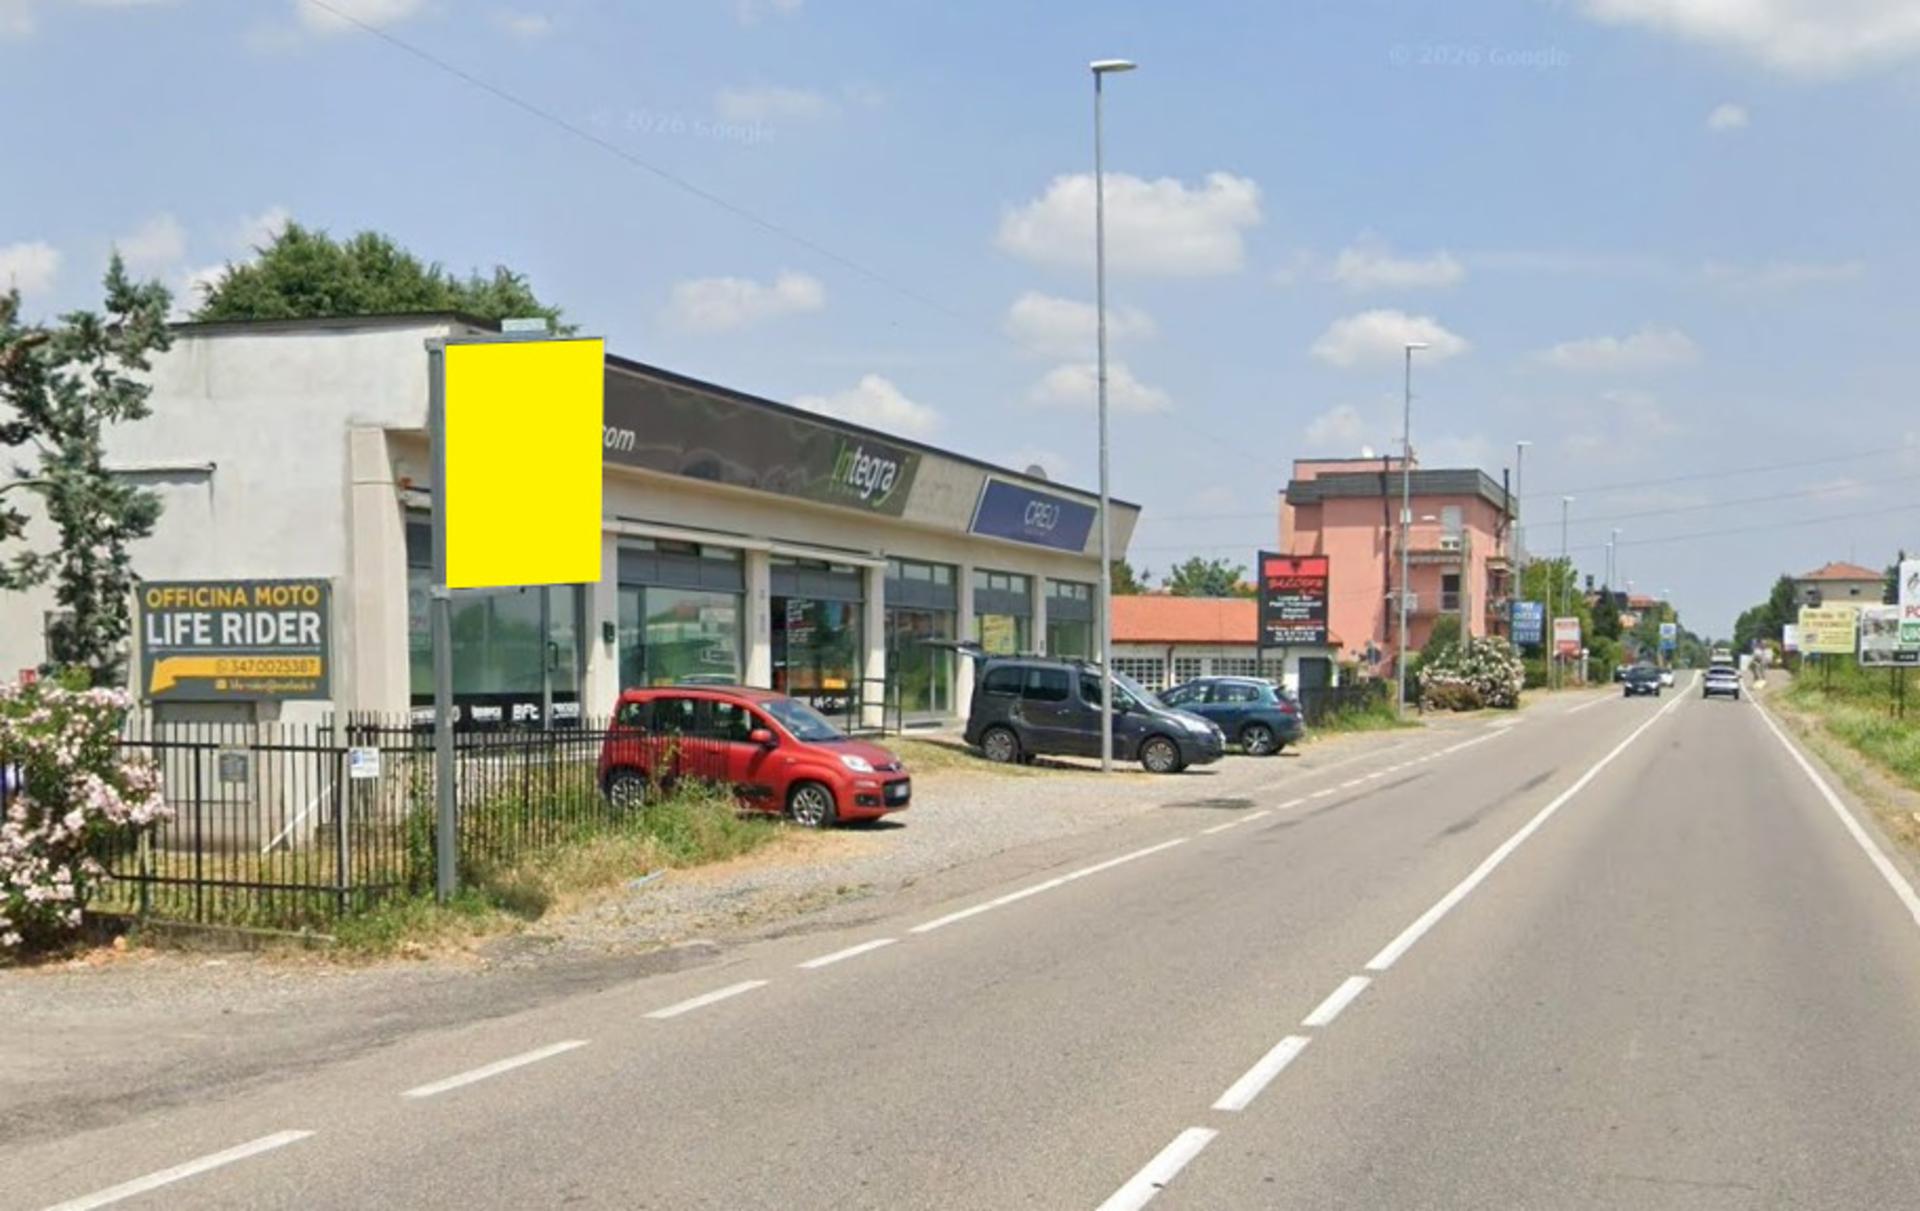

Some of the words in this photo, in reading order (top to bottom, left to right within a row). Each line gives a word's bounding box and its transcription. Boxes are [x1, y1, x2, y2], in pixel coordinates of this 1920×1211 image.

[146, 587, 249, 608] OFFICINA
[255, 585, 320, 607] MOTO
[147, 611, 212, 645] LIFE
[221, 610, 321, 645] RIDER
